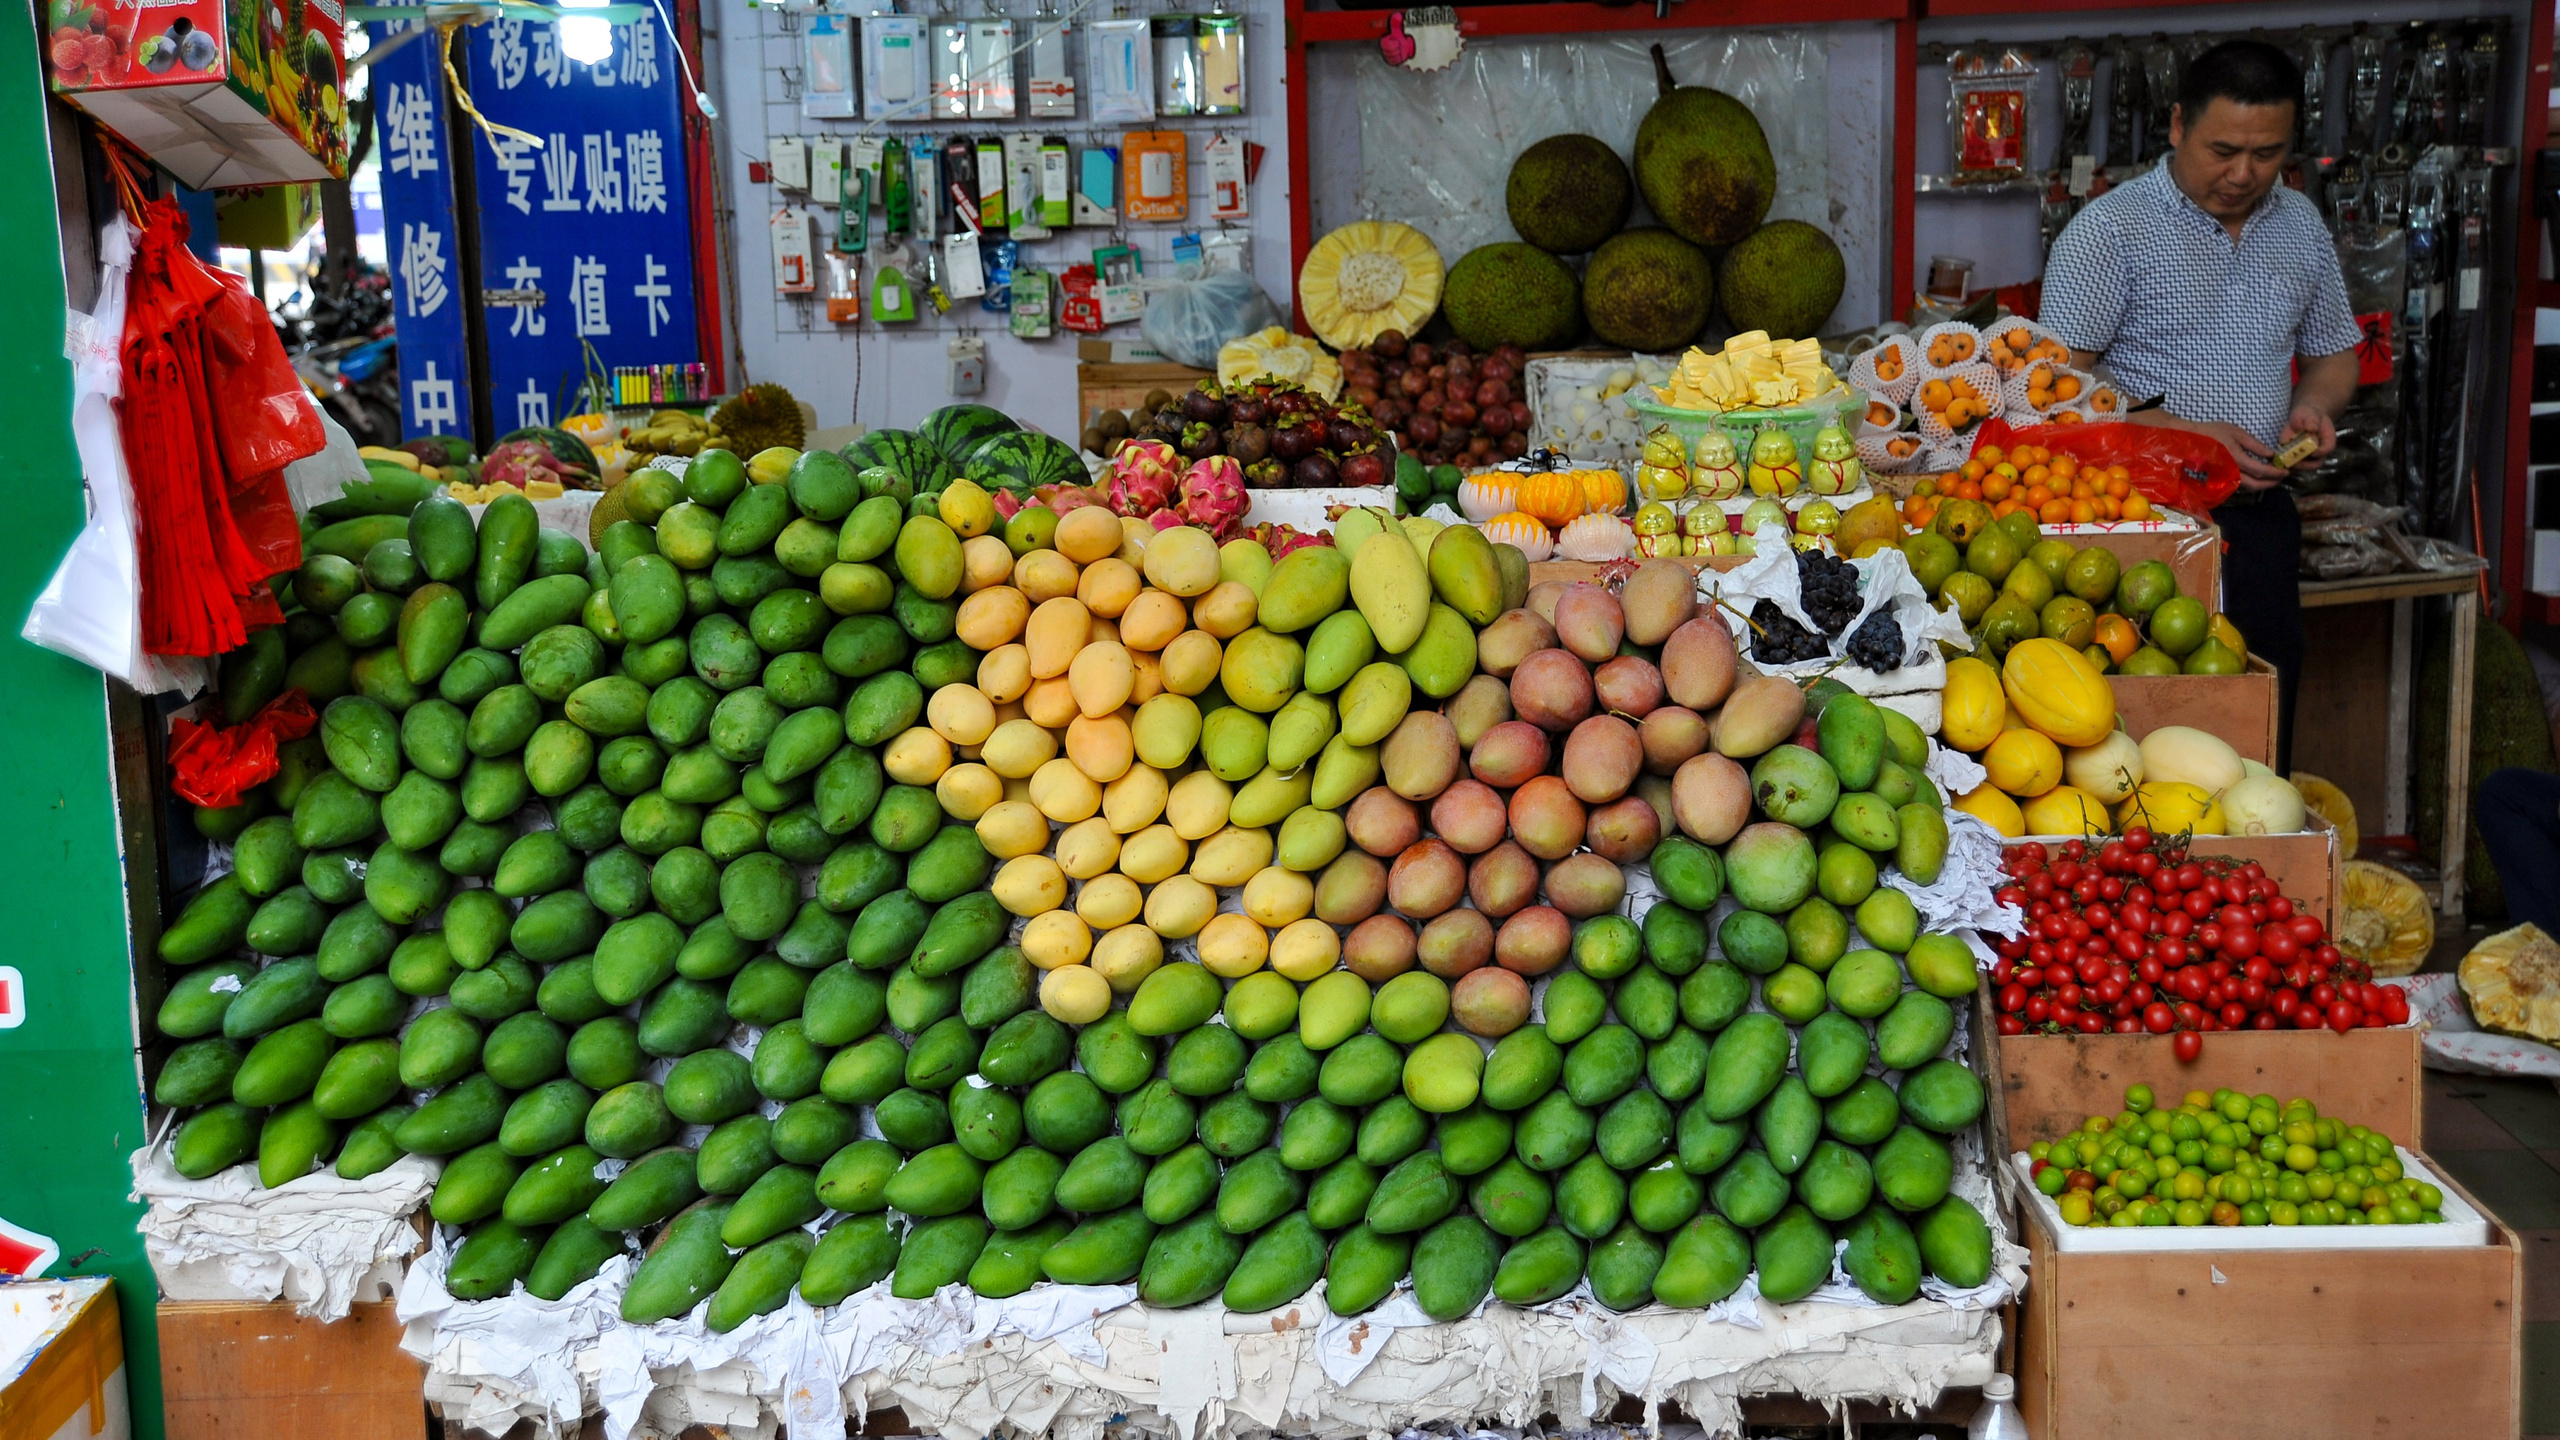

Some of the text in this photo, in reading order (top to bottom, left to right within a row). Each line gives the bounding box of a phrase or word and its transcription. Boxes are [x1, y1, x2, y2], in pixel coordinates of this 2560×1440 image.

[496, 129, 668, 215] 专业贴膜
[376, 0, 457, 435] 维修中
[505, 253, 672, 338] 充值卡
